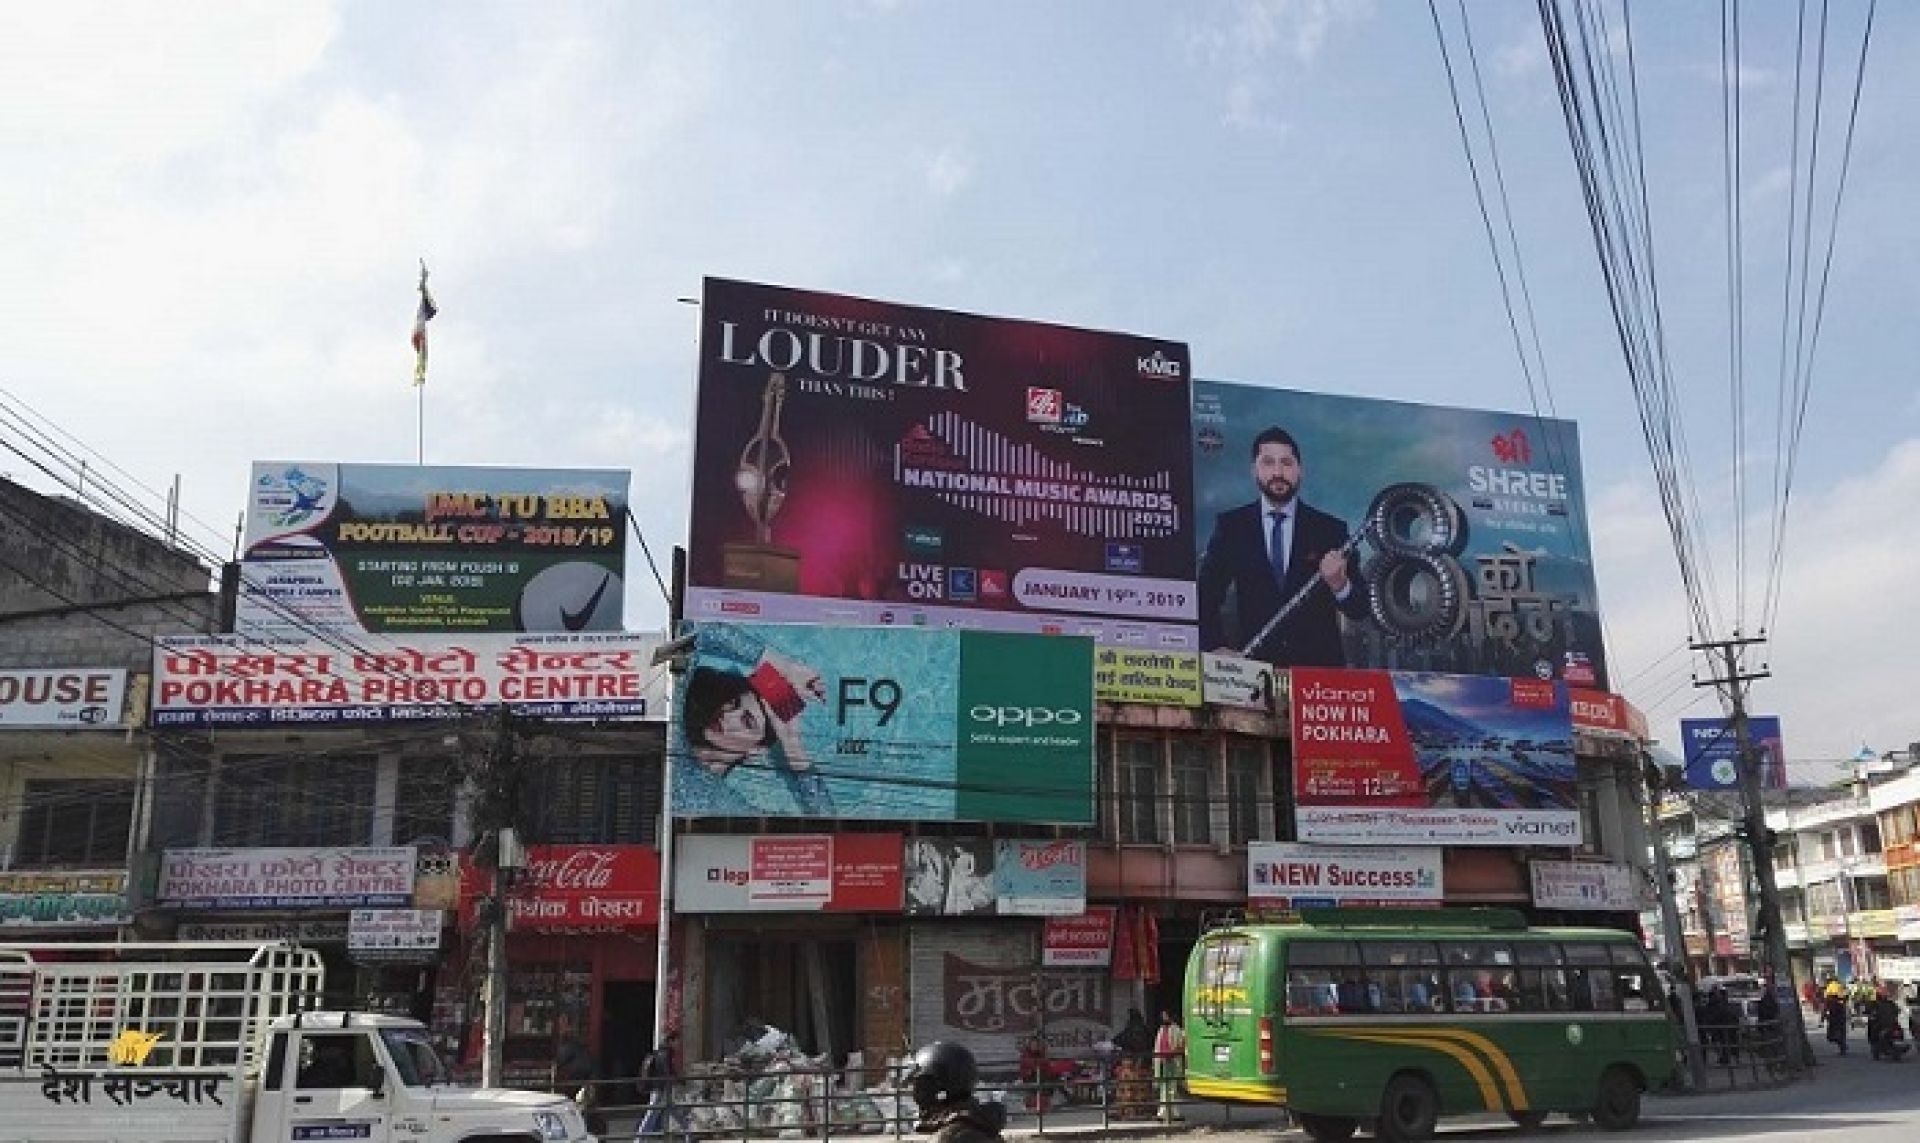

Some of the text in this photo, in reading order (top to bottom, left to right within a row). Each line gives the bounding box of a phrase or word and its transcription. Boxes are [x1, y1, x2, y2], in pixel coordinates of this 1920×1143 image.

[719, 320, 968, 393] LOUDER
[904, 468, 1173, 511] NATIONAL MUSIC AWARDS
[1469, 465, 1567, 500] SHREE
[498, 495, 538, 519] TU
[545, 495, 610, 520] BBA
[338, 522, 454, 542] FOOTBALL
[458, 525, 506, 544] CUP
[898, 562, 945, 582] LIVE
[906, 581, 943, 600] ON
[1022, 581, 1101, 602] JANUARY
[1148, 590, 1187, 608] 2019
[161, 673, 640, 705] POKHARA PHOTO CENTRE
[1302, 682, 1375, 702] vianet
[836, 676, 904, 728] F9
[970, 704, 1082, 728] oppo
[1302, 706, 1370, 723] NOW IN
[1302, 726, 1391, 744] POKHARA
[1504, 814, 1577, 836] vianet
[1271, 863, 1320, 886] NEW
[165, 879, 257, 897] POKHARA
[262, 879, 327, 895] PHOTO
